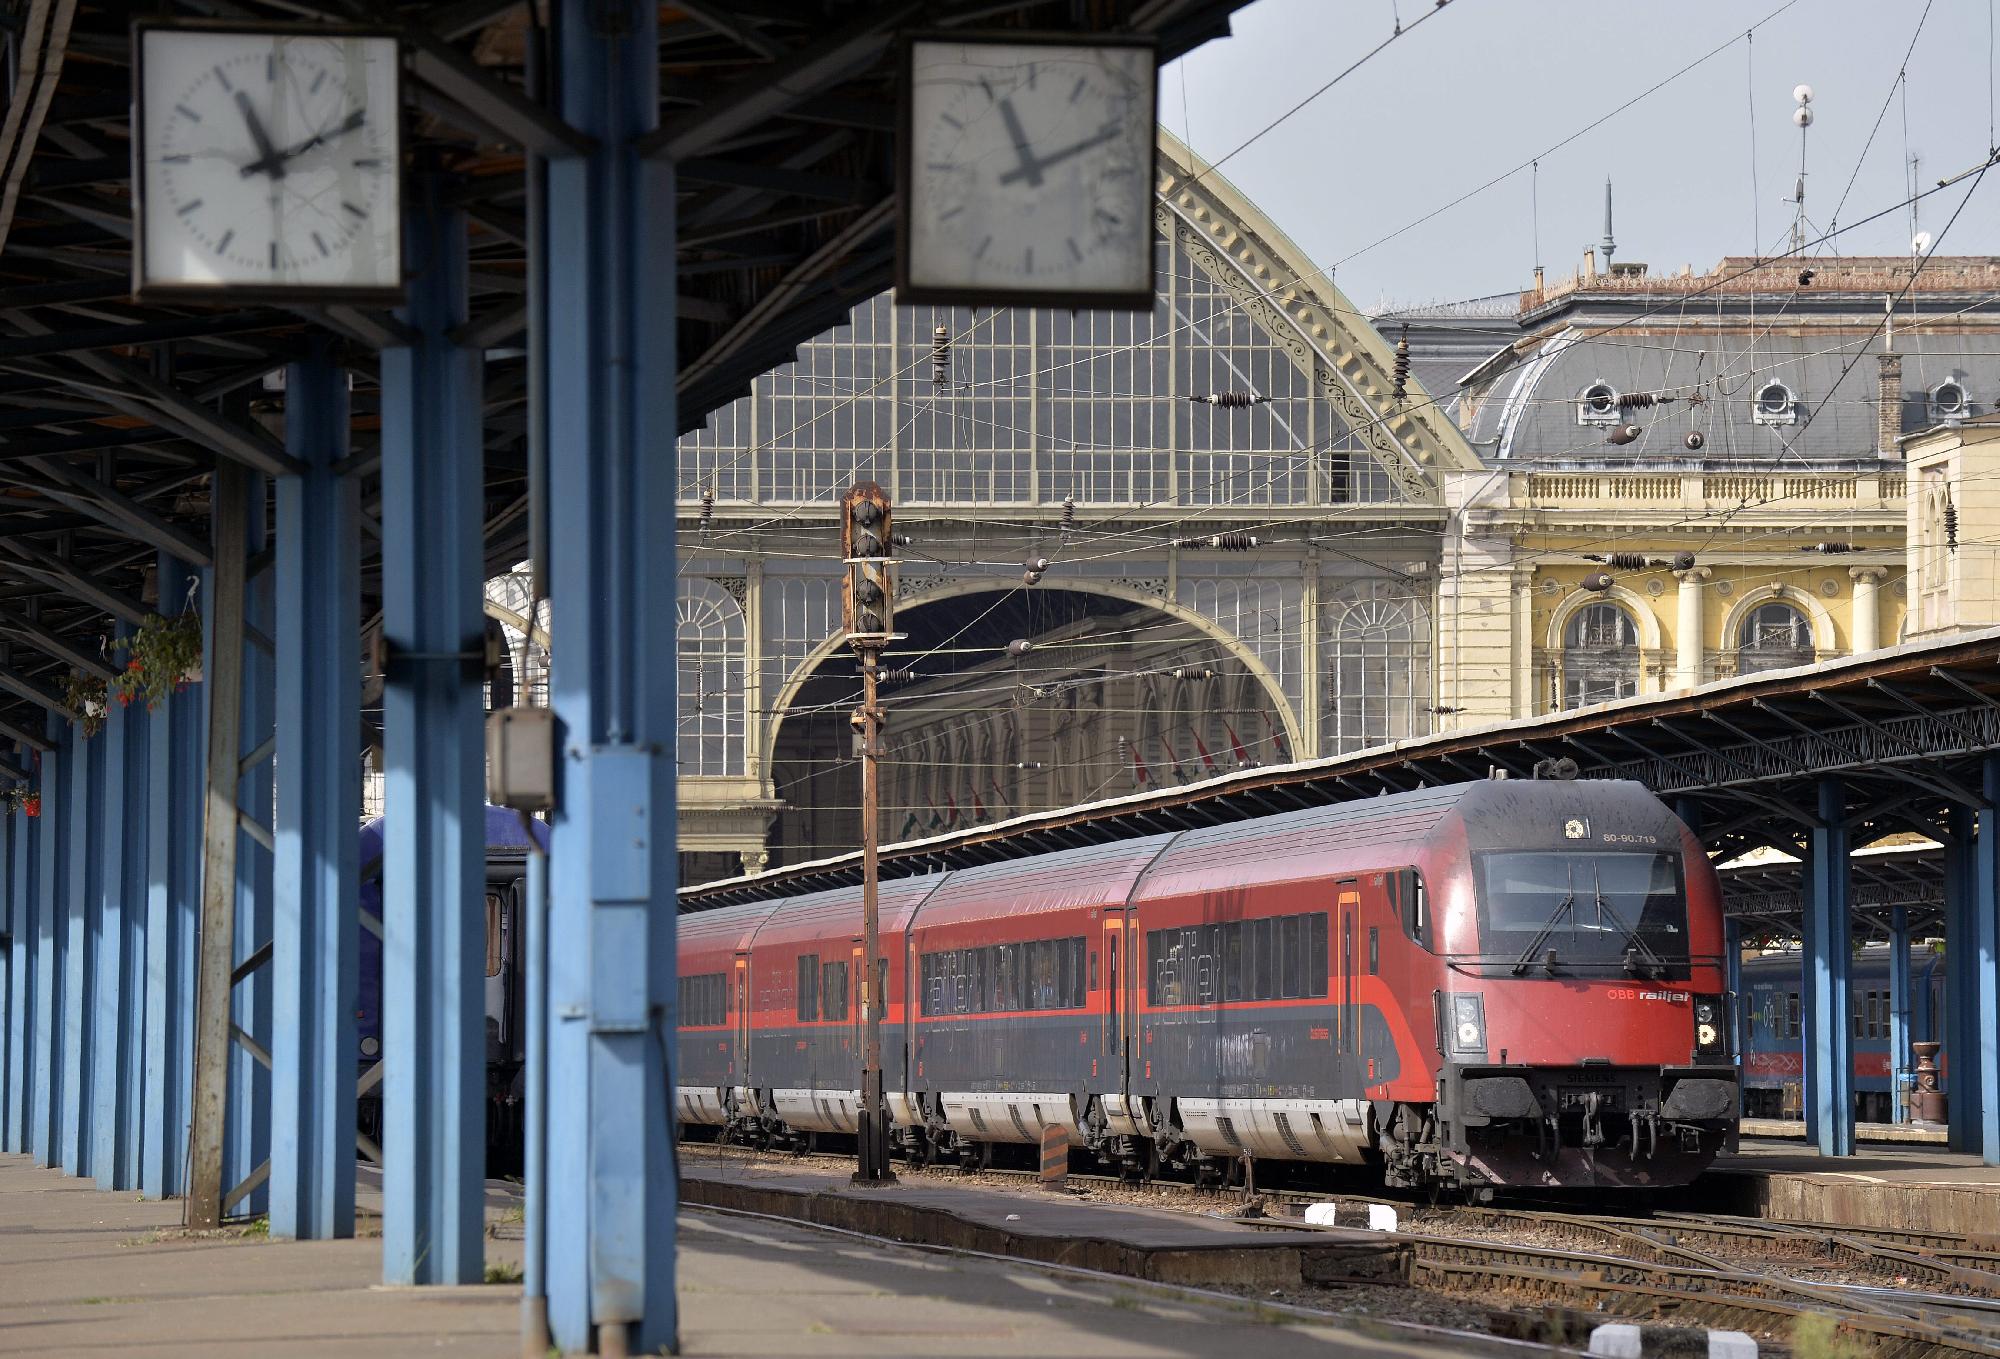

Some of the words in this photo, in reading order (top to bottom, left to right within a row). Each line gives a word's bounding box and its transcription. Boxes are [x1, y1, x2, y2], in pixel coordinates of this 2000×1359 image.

[1603, 833, 1657, 844] 80-90.719
[1639, 990, 1690, 1003] railjet
[1567, 1073, 1617, 1083] SIEMENS
